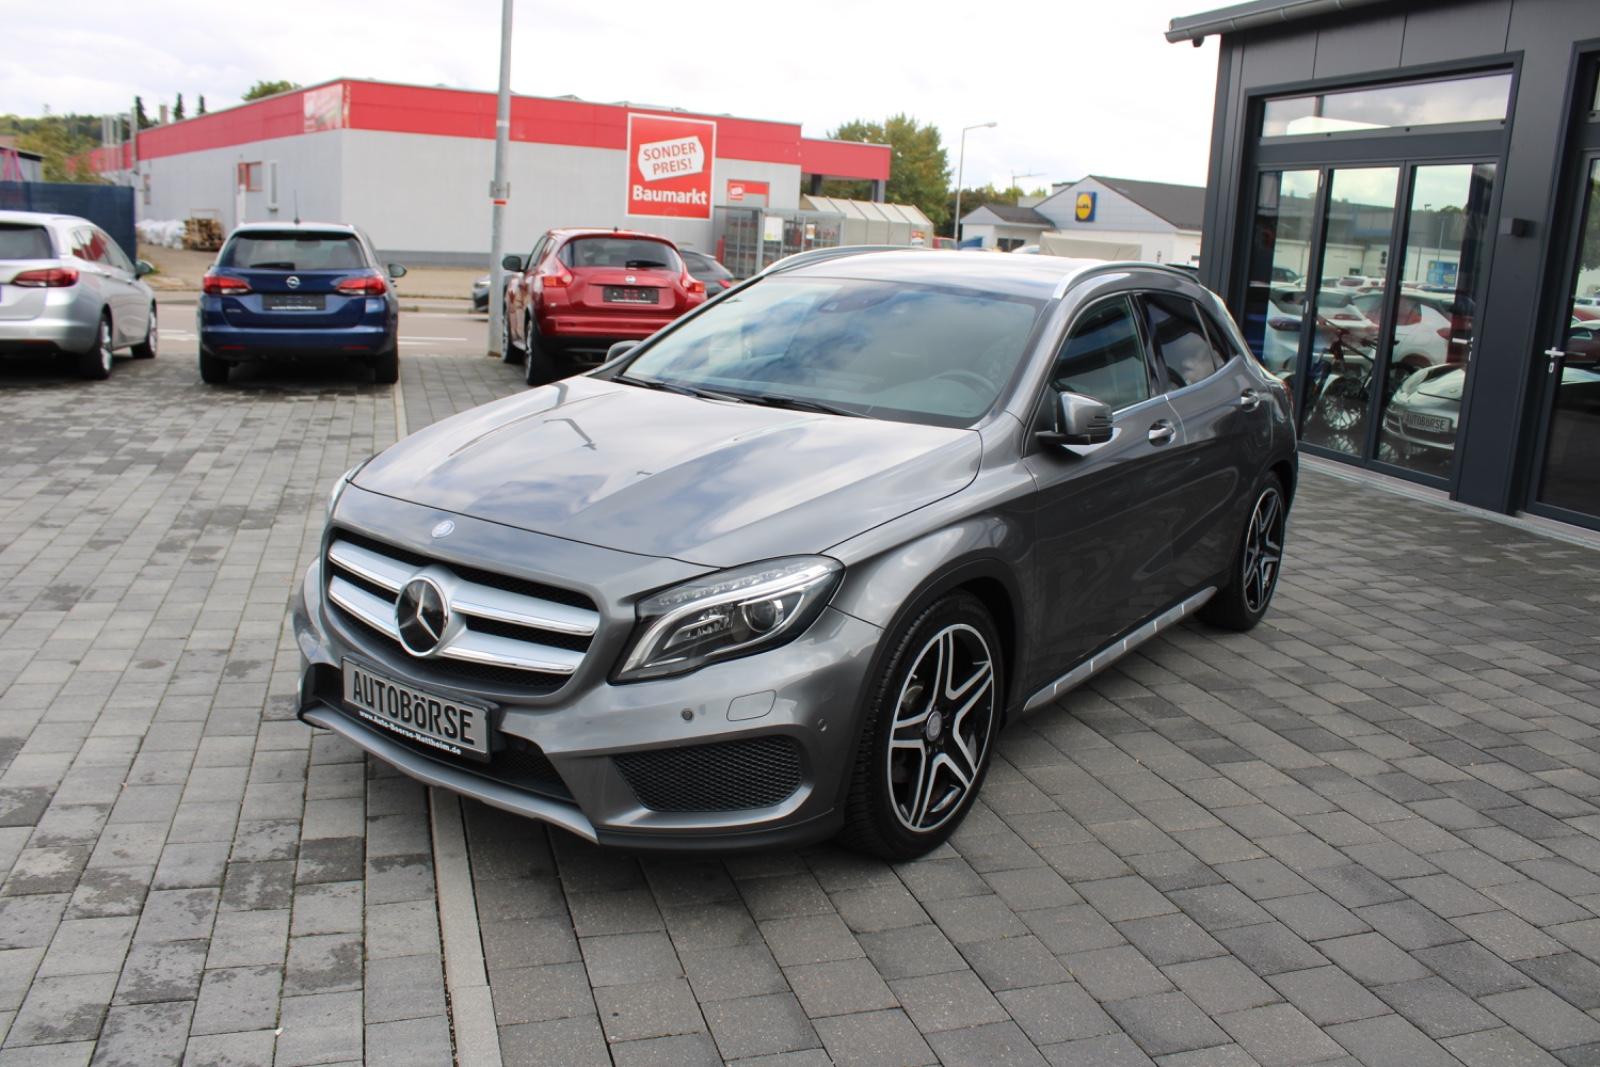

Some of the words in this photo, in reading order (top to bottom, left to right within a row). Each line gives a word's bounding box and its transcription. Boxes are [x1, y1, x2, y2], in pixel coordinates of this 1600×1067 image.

[643, 142, 696, 160] SONDER
[653, 159, 692, 174] PREIS!
[632, 184, 707, 205] Baumarkt
[353, 671, 474, 744] AUTOBÖRSE
